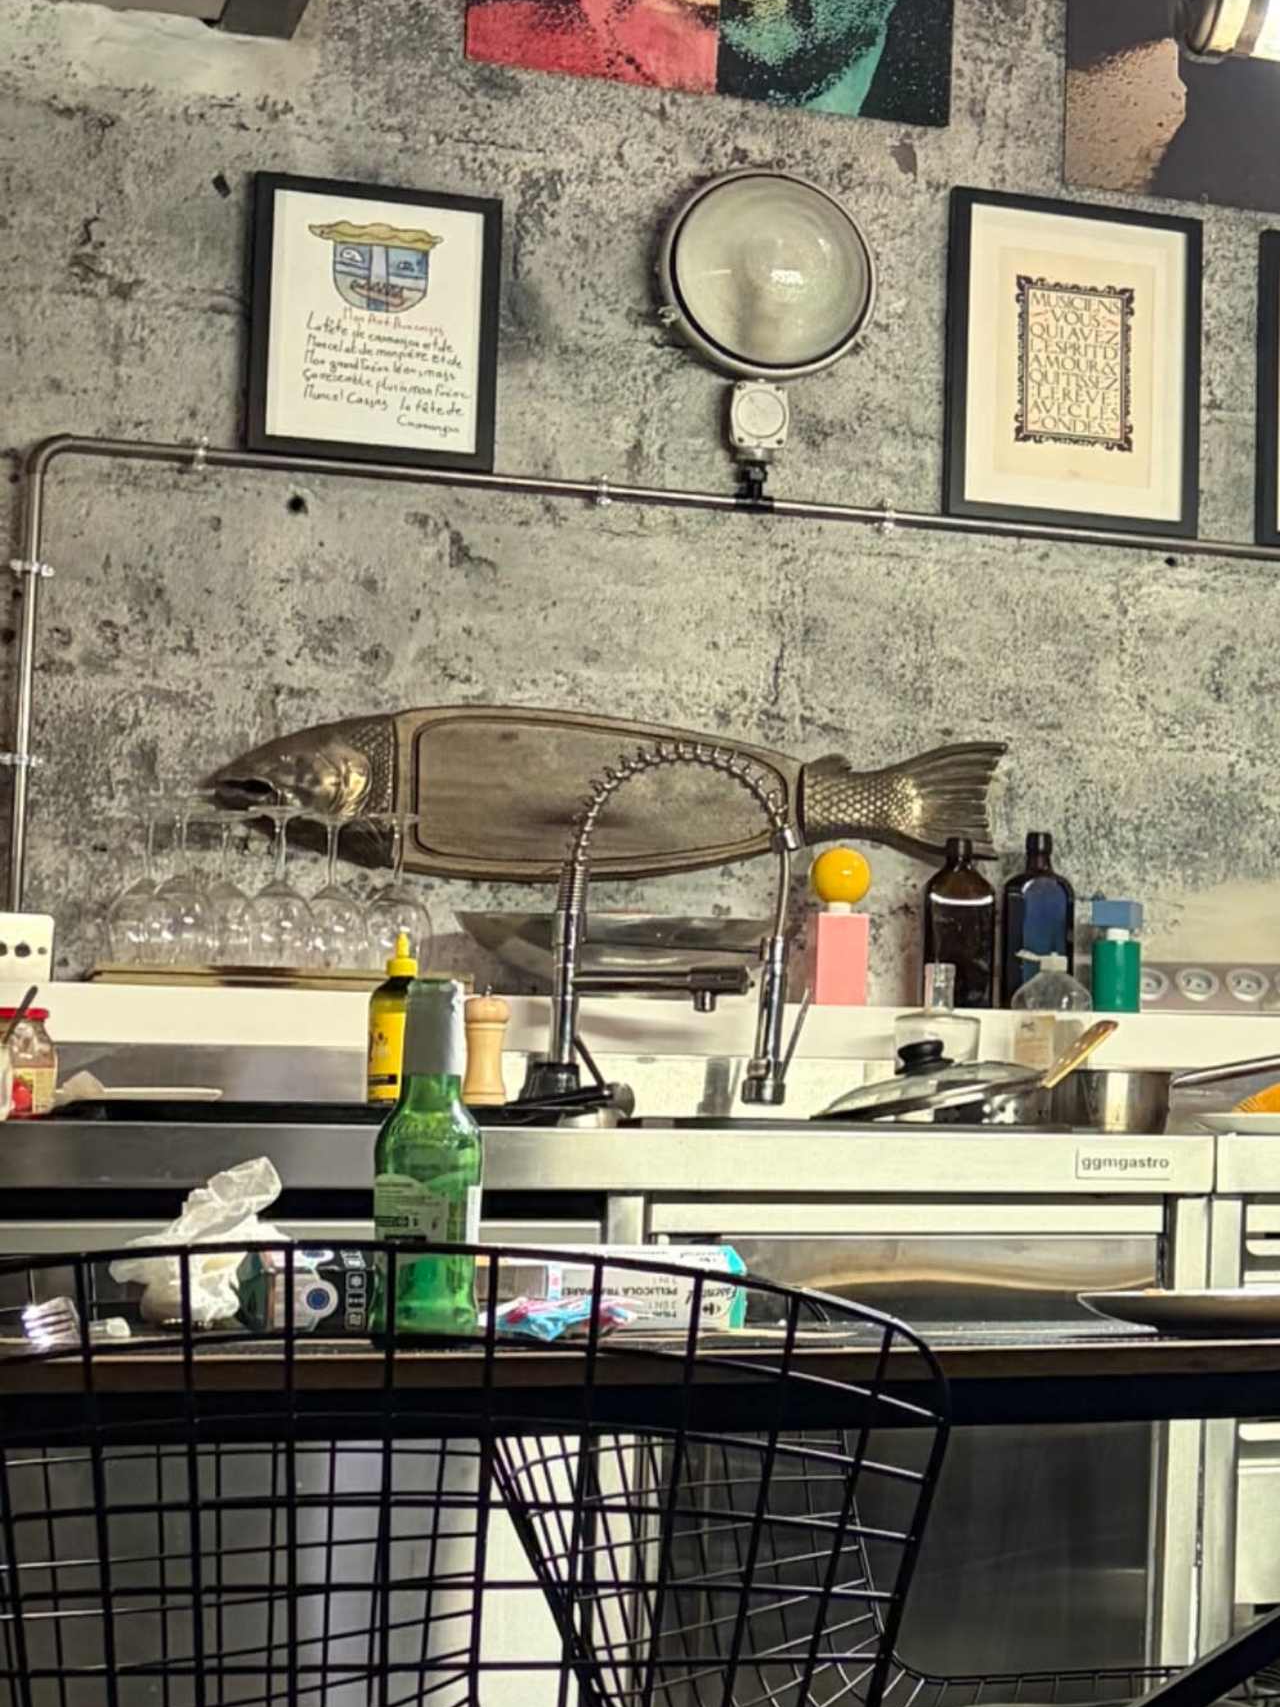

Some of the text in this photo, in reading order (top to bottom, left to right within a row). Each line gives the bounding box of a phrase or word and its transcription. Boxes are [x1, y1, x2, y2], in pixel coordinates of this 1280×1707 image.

[1030, 292, 1120, 314] MUSICIENS
[1051, 309, 1101, 327] VOUS
[1081, 1156, 1170, 1171] ggmgastro
